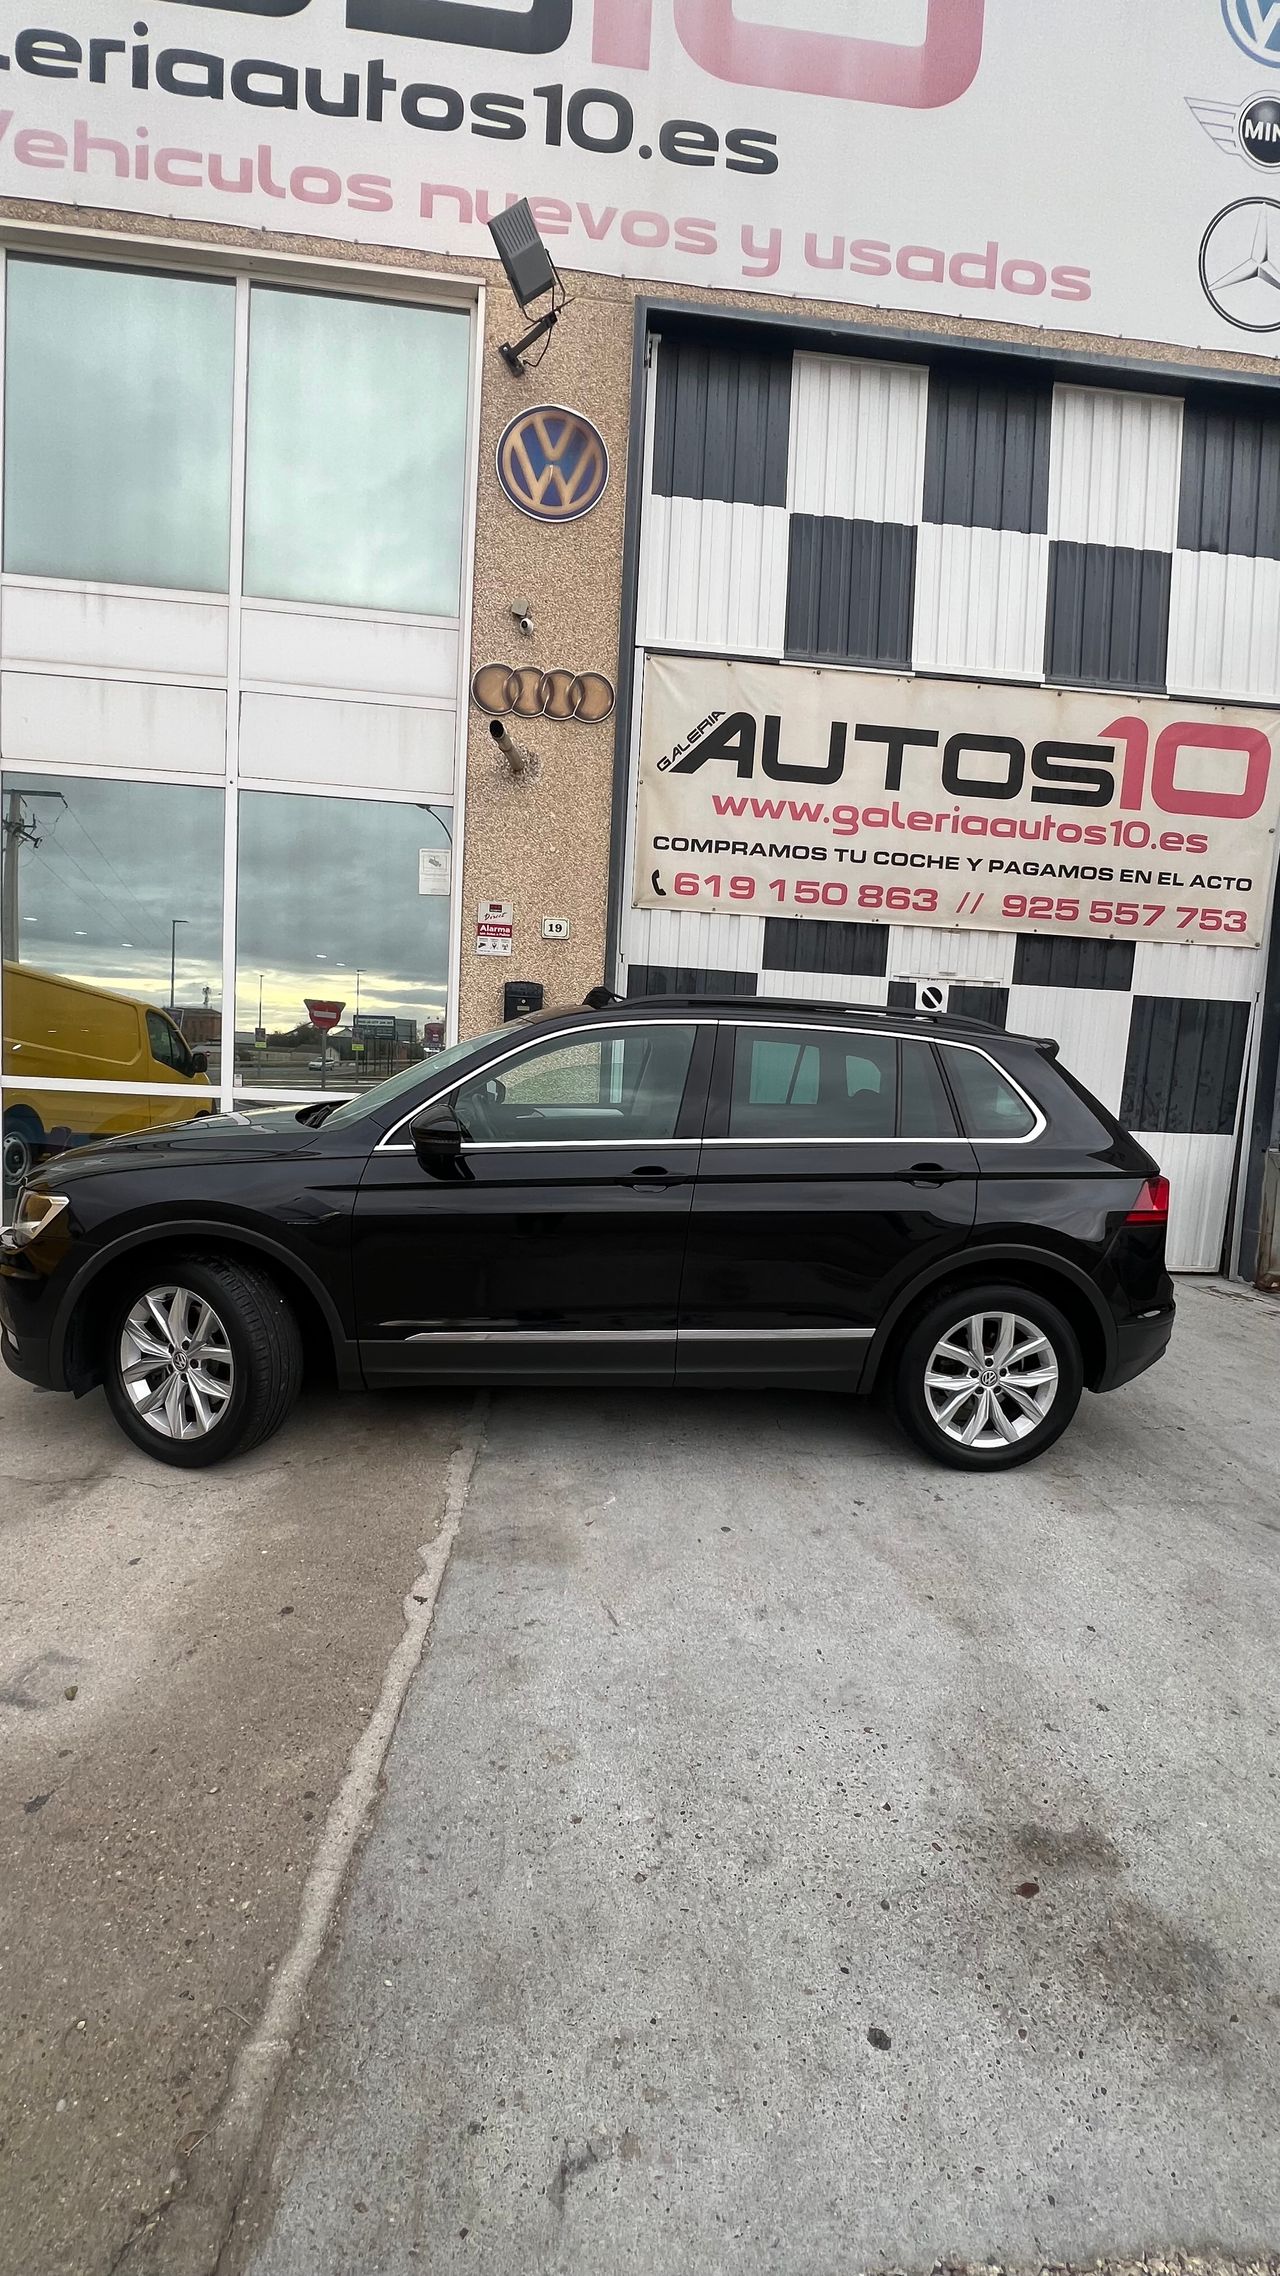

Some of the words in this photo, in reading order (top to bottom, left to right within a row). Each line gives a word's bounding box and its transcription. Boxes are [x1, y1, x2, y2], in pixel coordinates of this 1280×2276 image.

[0, 21, 779, 176] eriaautos10.es
[740, 226, 782, 279] y
[804, 233, 1092, 302] usados
[656, 711, 727, 772] GALERIA
[711, 795, 1208, 854] www.galeriaautos10.es
[652, 836, 828, 862] COMPRAMOS
[834, 848, 868, 865] TU
[872, 850, 960, 872] COCHE
[966, 857, 984, 872] Y
[987, 859, 1114, 883] PAGAMOS
[1119, 869, 1153, 884] EN
[1157, 872, 1185, 887] EL
[1189, 875, 1253, 892] ACTO
[480, 924, 511, 933] Alarma
[548, 923, 563, 933] 19
[672, 871, 756, 901] 619
[768, 879, 848, 907] 150
[857, 885, 939, 913] 863
[1002, 894, 1080, 922] 925
[1089, 900, 1168, 927] 557
[1176, 906, 1248, 934] 753
